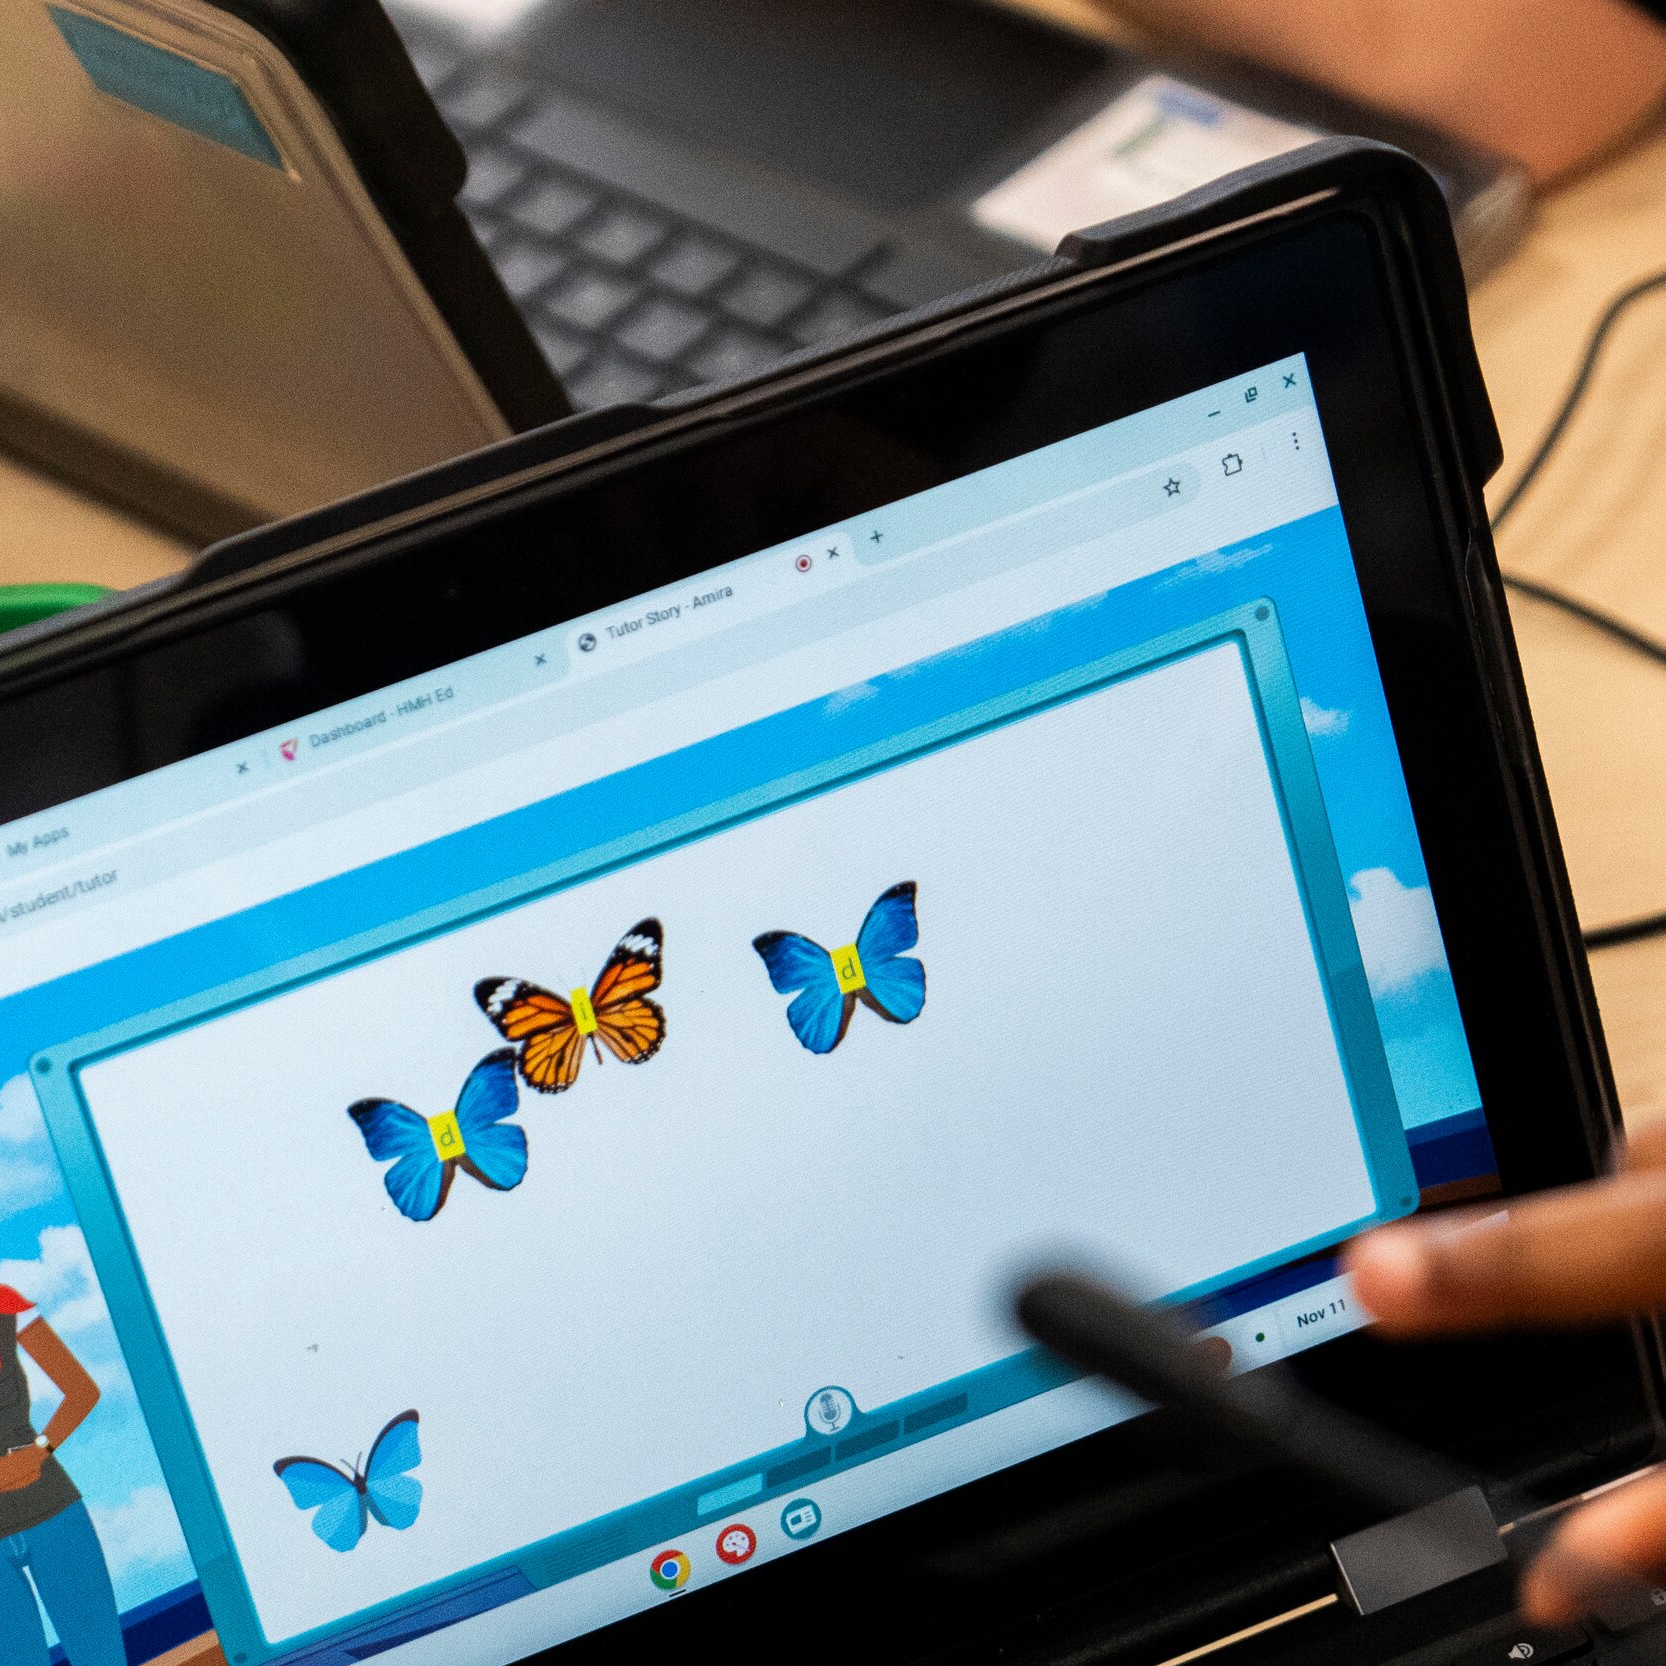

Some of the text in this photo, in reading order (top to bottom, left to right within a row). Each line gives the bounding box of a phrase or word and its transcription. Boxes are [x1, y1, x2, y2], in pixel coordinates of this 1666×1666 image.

[606, 618, 643, 639] Tutor
[646, 604, 681, 625] Story
[693, 585, 733, 609] Amira
[310, 711, 386, 748] Dashboard
[397, 692, 432, 715] HMH
[435, 685, 454, 701] Ed
[6, 827, 69, 858] My Apps
[841, 956, 856, 979] d
[440, 1123, 455, 1147] d
[1297, 1299, 1346, 1328] Nov 11
